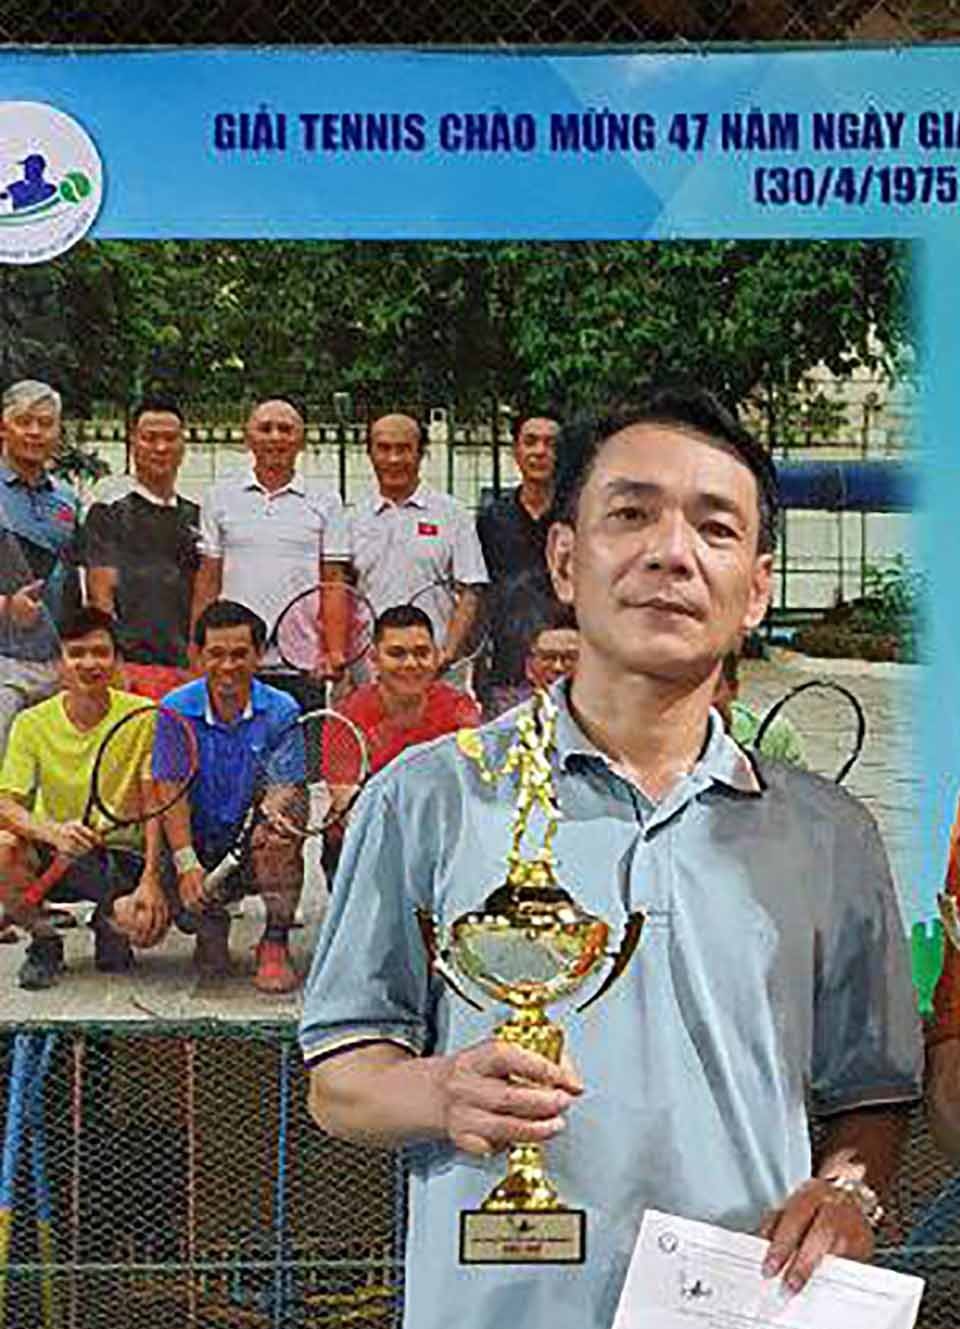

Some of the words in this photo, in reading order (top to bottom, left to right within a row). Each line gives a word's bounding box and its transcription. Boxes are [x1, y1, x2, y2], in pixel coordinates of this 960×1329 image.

[214, 101, 287, 151] GIẢI
[299, 113, 427, 152] TENNIS
[439, 105, 537, 152] CHÀO
[667, 112, 709, 152] 47
[812, 104, 905, 151] NGÀY
[754, 165, 958, 207] (30/4/1975
